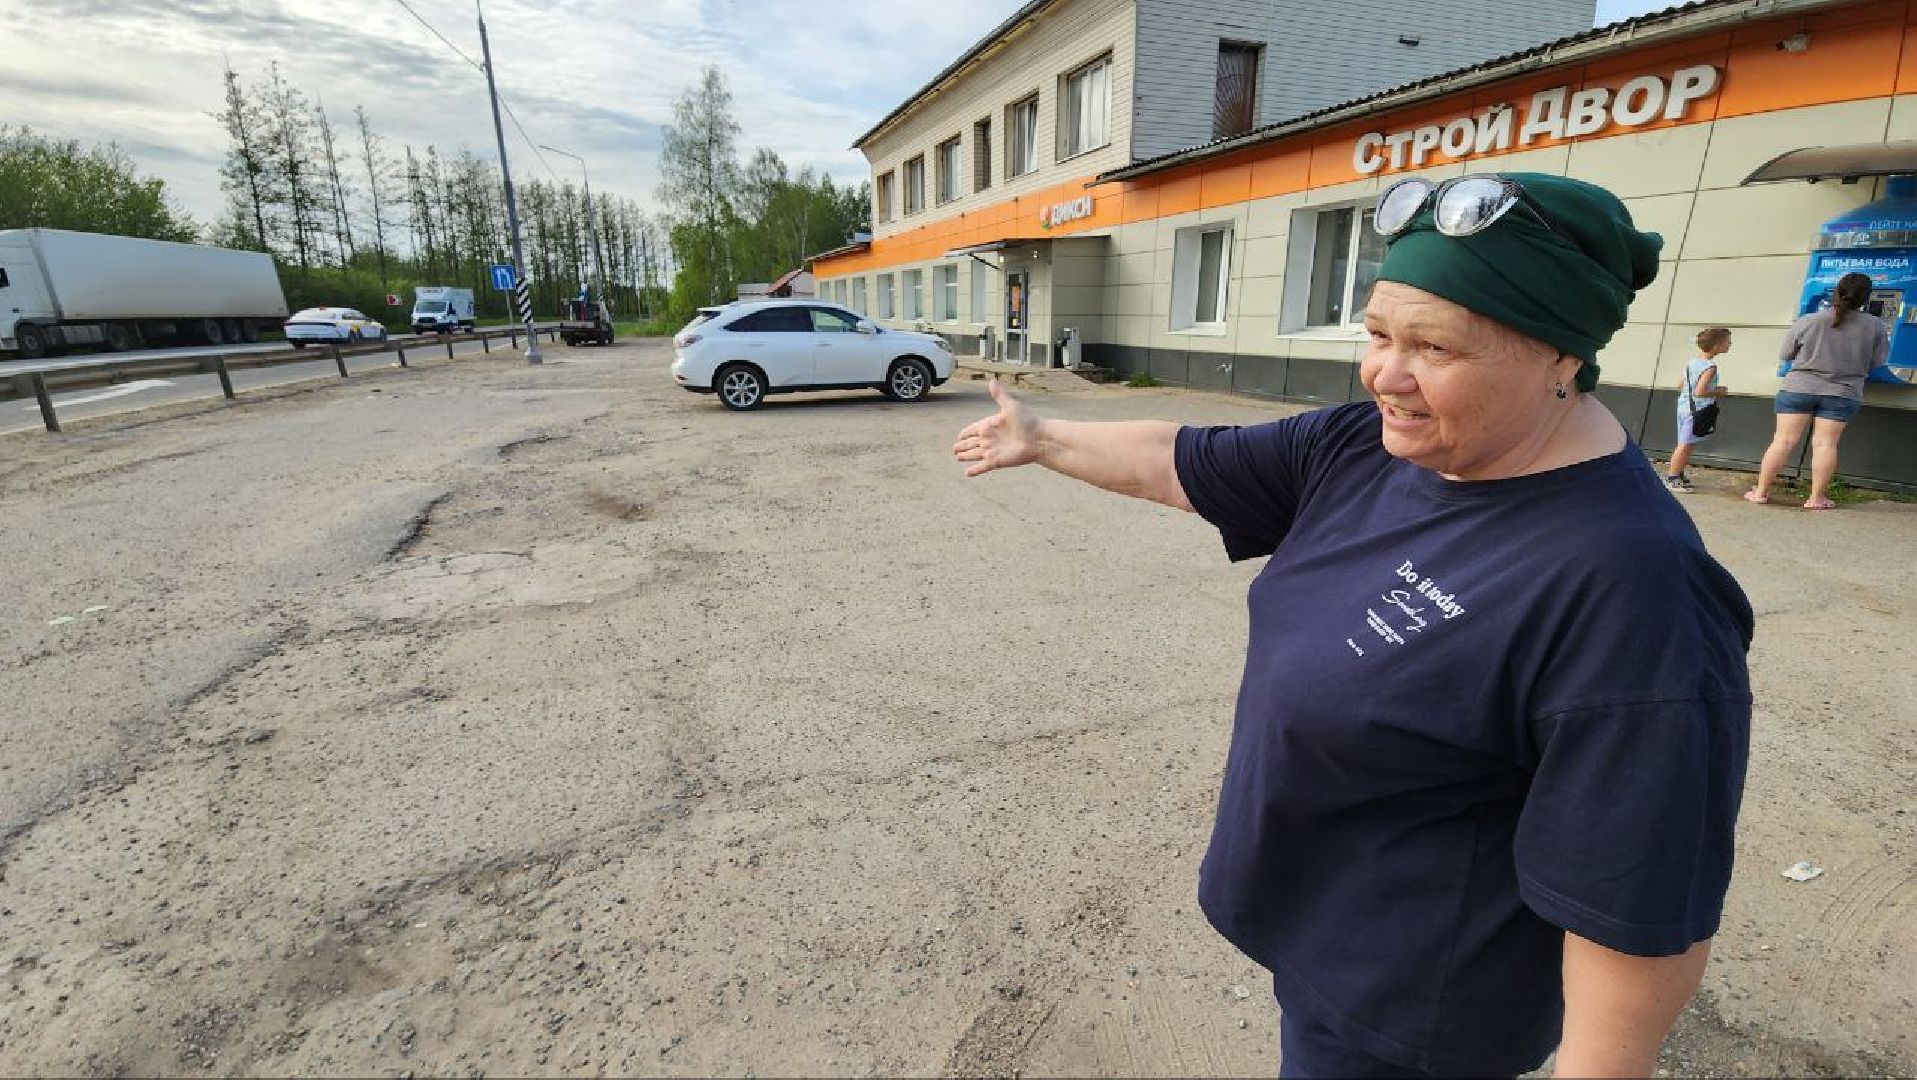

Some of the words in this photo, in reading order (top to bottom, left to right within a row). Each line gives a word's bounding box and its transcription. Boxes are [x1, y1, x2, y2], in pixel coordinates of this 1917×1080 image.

[1353, 103, 1517, 174] СТРОЙ
[1519, 64, 1722, 144] ДВОР
[1051, 196, 1092, 226] ДИКСИ
[1821, 257, 1873, 269] ПИТЬЕВАЯ
[1875, 257, 1909, 269] ВОДА
[1395, 560, 1418, 584] Do
